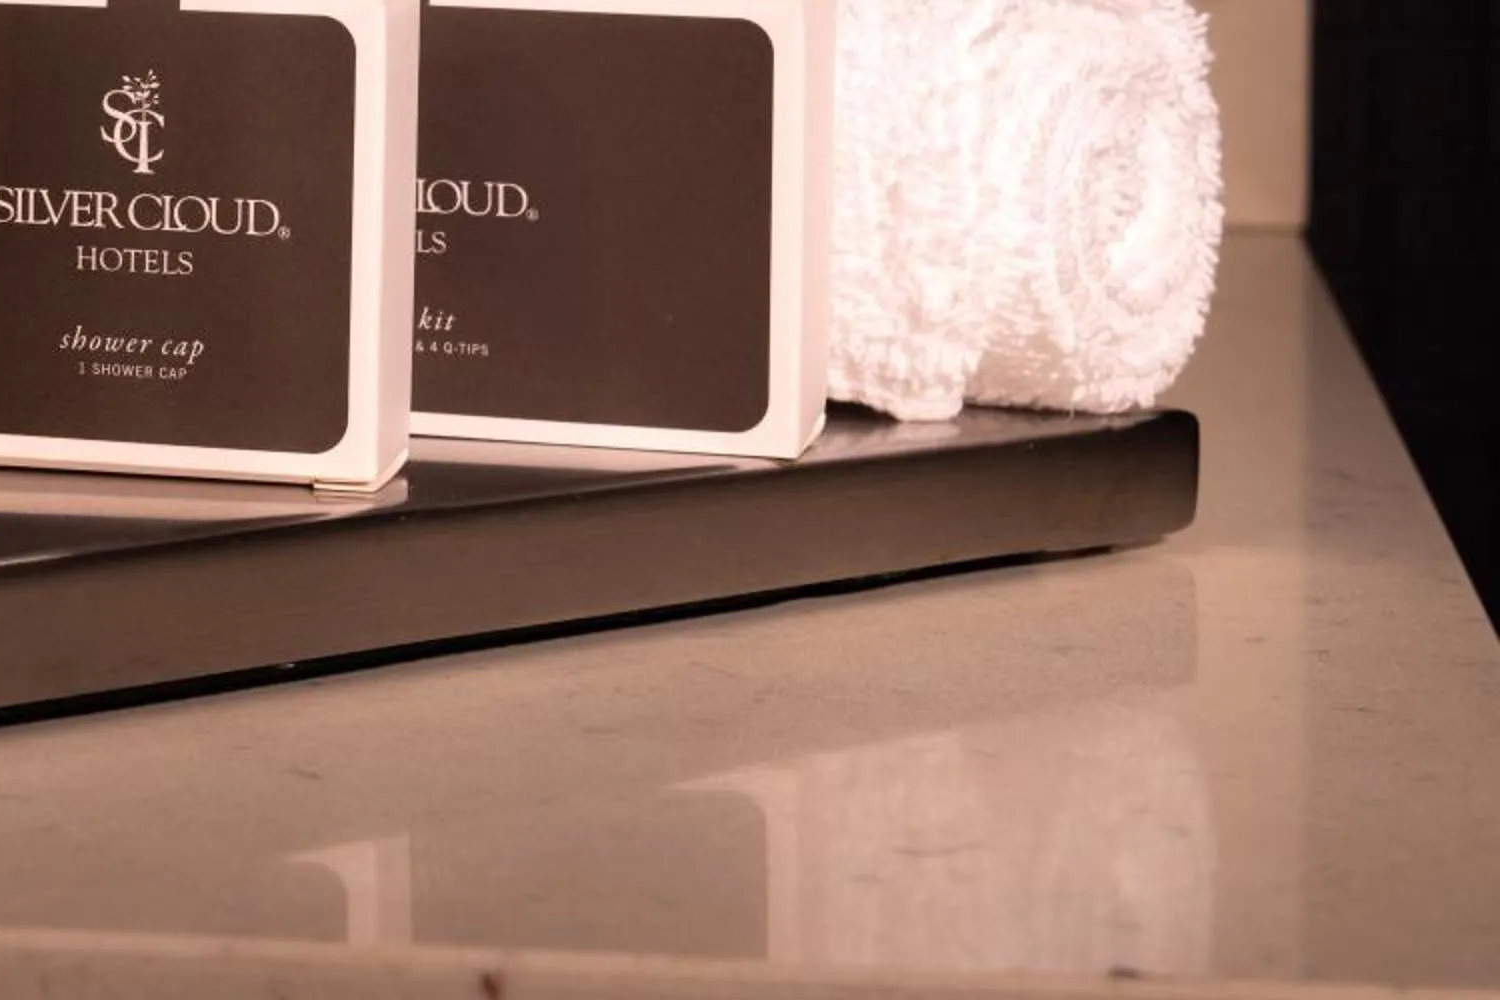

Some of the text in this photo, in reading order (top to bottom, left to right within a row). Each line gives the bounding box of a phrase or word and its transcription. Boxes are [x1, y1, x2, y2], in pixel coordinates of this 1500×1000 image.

[417, 229, 447, 254] LS
[76, 245, 193, 276] HOTELS
[418, 306, 456, 331] kit
[59, 325, 205, 365] shower cap
[92, 362, 153, 377] SHOWER
[159, 367, 187, 380] CAP
